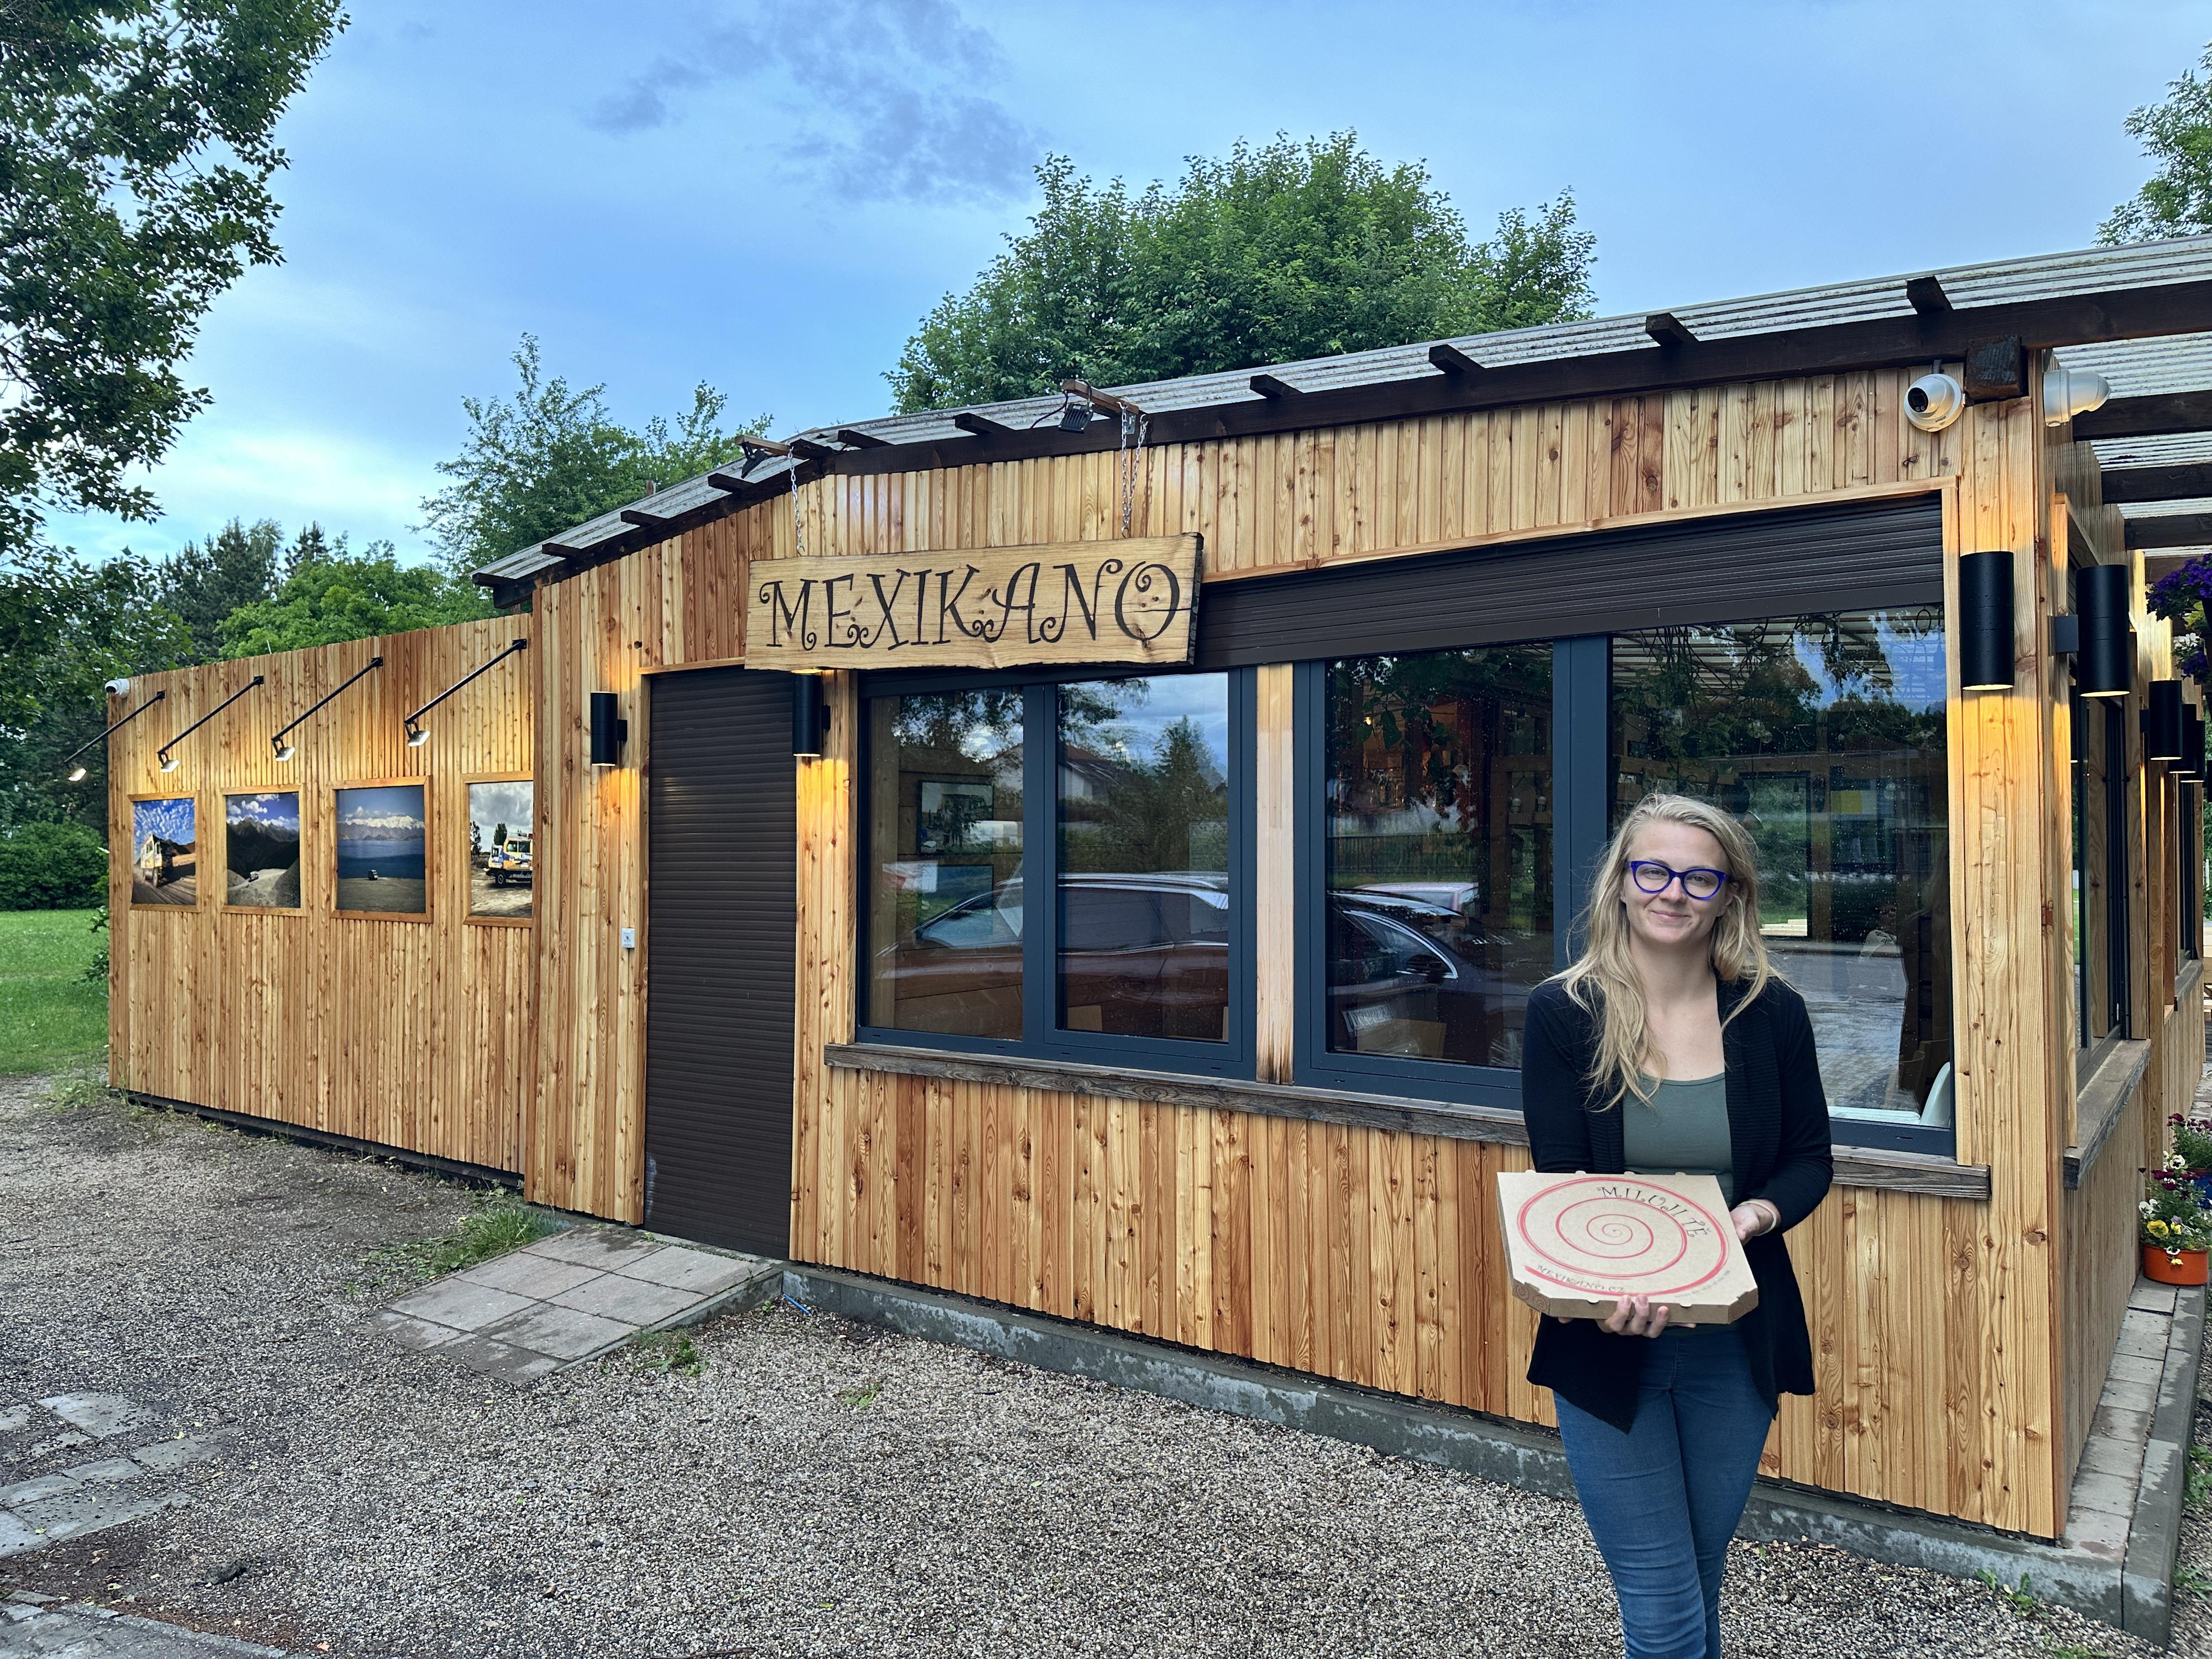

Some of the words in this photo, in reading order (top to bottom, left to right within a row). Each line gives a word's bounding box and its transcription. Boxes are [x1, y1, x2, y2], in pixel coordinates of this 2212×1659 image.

[759, 559, 1181, 651] MEXIKANO
[1597, 1186, 1689, 1217] MILUJI
[1681, 1217, 1712, 1238] TĚ
